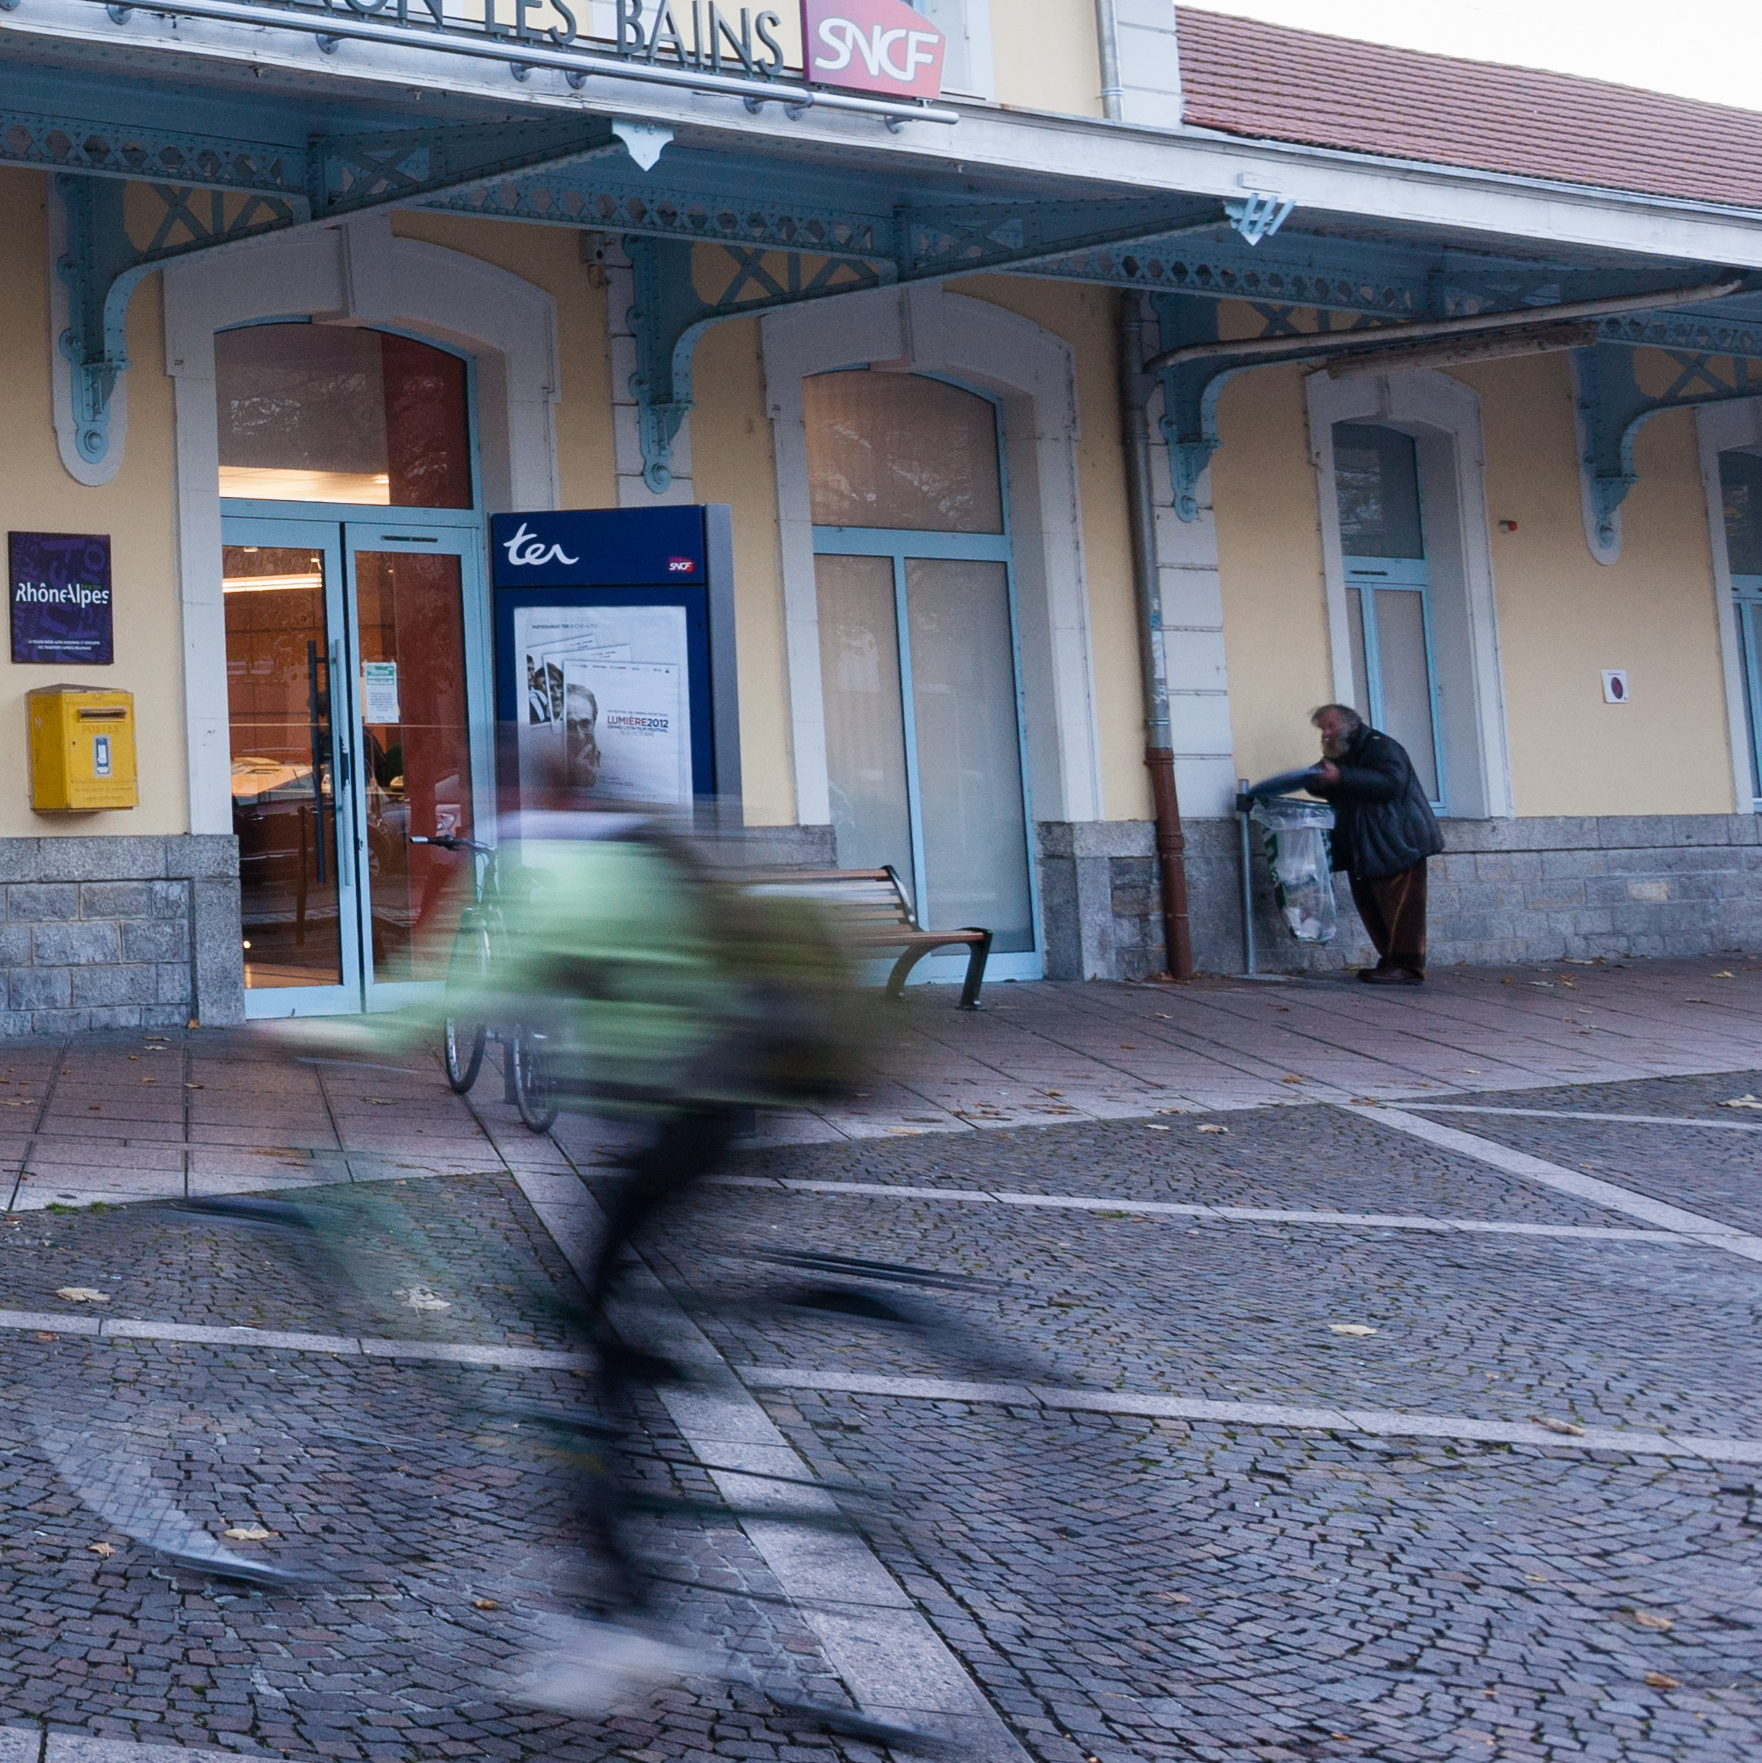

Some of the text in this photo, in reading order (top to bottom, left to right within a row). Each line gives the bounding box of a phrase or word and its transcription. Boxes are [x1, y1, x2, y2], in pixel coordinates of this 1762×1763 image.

[814, 17, 942, 82] SNCF
[503, 523, 579, 566] ter
[668, 561, 693, 571] SNCF
